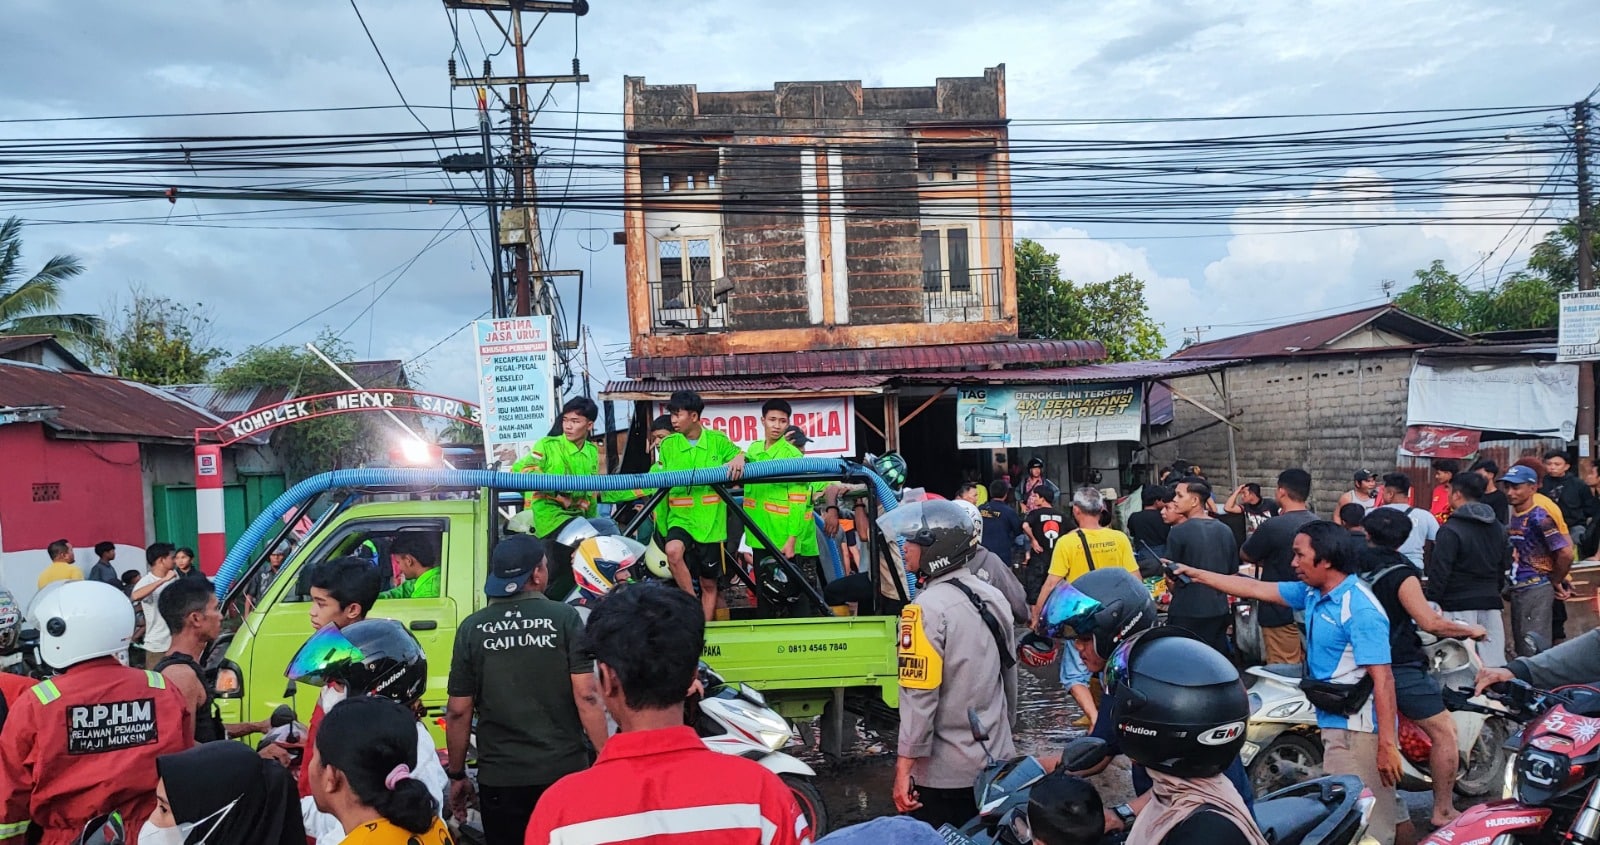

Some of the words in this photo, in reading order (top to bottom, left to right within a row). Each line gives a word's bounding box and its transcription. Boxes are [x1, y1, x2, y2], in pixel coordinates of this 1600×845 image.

[493, 320, 532, 331] TERIMA
[485, 331, 512, 342] JASA
[516, 330, 541, 340] URUT
[482, 345, 508, 353] KHUSUS
[509, 343, 546, 352] PEREMPUAN
[494, 355, 528, 364] KECAPEAN
[495, 363, 538, 372] PEGAL-PEGAL
[495, 374, 524, 382] KESELEO
[496, 385, 517, 393] SALAH
[1015, 391, 1067, 400] BENGKEL
[1068, 390, 1081, 399] INI
[1084, 387, 1134, 398] TERSEDIA
[497, 395, 520, 403] MASUK
[521, 394, 540, 402] ANGIN
[961, 390, 986, 400] TAG
[1015, 400, 1041, 411] AKI
[1044, 394, 1134, 409] BERGARANSI
[229, 402, 309, 438] KOMPLEK
[336, 391, 394, 410] MEKAR
[422, 396, 460, 417] SARI
[510, 405, 529, 413] HAMIL
[1018, 407, 1075, 421] TANPA
[1077, 404, 1129, 418] RIBET
[499, 423, 533, 432] ANAK-ANAK
[522, 618, 558, 632] DPR
[483, 636, 515, 651] GAJI
[788, 644, 807, 653] 0813
[809, 643, 828, 652] 4546
[829, 642, 848, 651] 7840
[901, 668, 923, 679] KAPUR
[72, 701, 152, 729] R.P.H.M
[72, 727, 112, 739] RELAWAN
[114, 721, 155, 734] PEMADAM
[1211, 727, 1239, 740] GM
[80, 739, 104, 750] HAJI
[108, 733, 146, 746] MUKSIN
